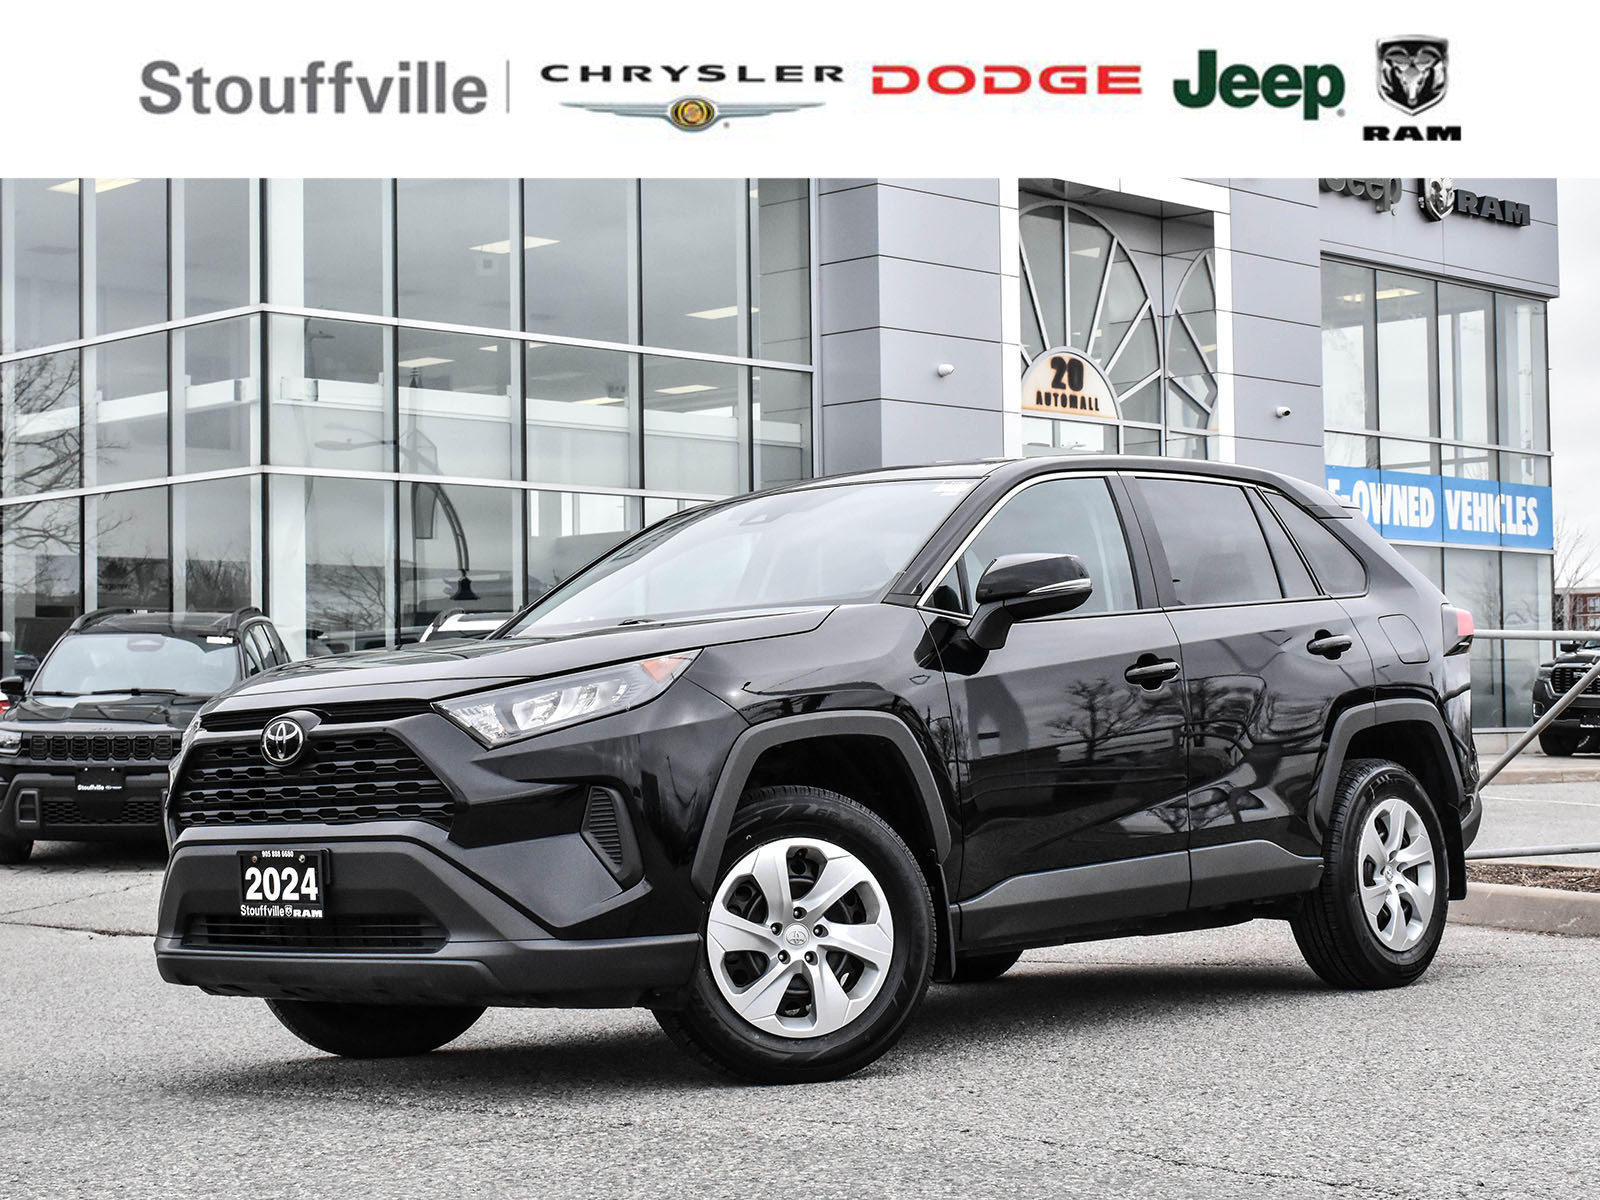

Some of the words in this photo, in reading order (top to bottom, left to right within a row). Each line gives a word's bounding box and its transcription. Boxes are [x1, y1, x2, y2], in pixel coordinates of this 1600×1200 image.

[1454, 189, 1531, 226] RAM
[1050, 356, 1084, 392] 20
[1035, 390, 1100, 412] AUTOMALL
[1444, 489, 1539, 537] VEHICLES
[244, 866, 319, 902] 2024
[240, 904, 285, 917] Stouffville
[293, 909, 323, 918] RAM
